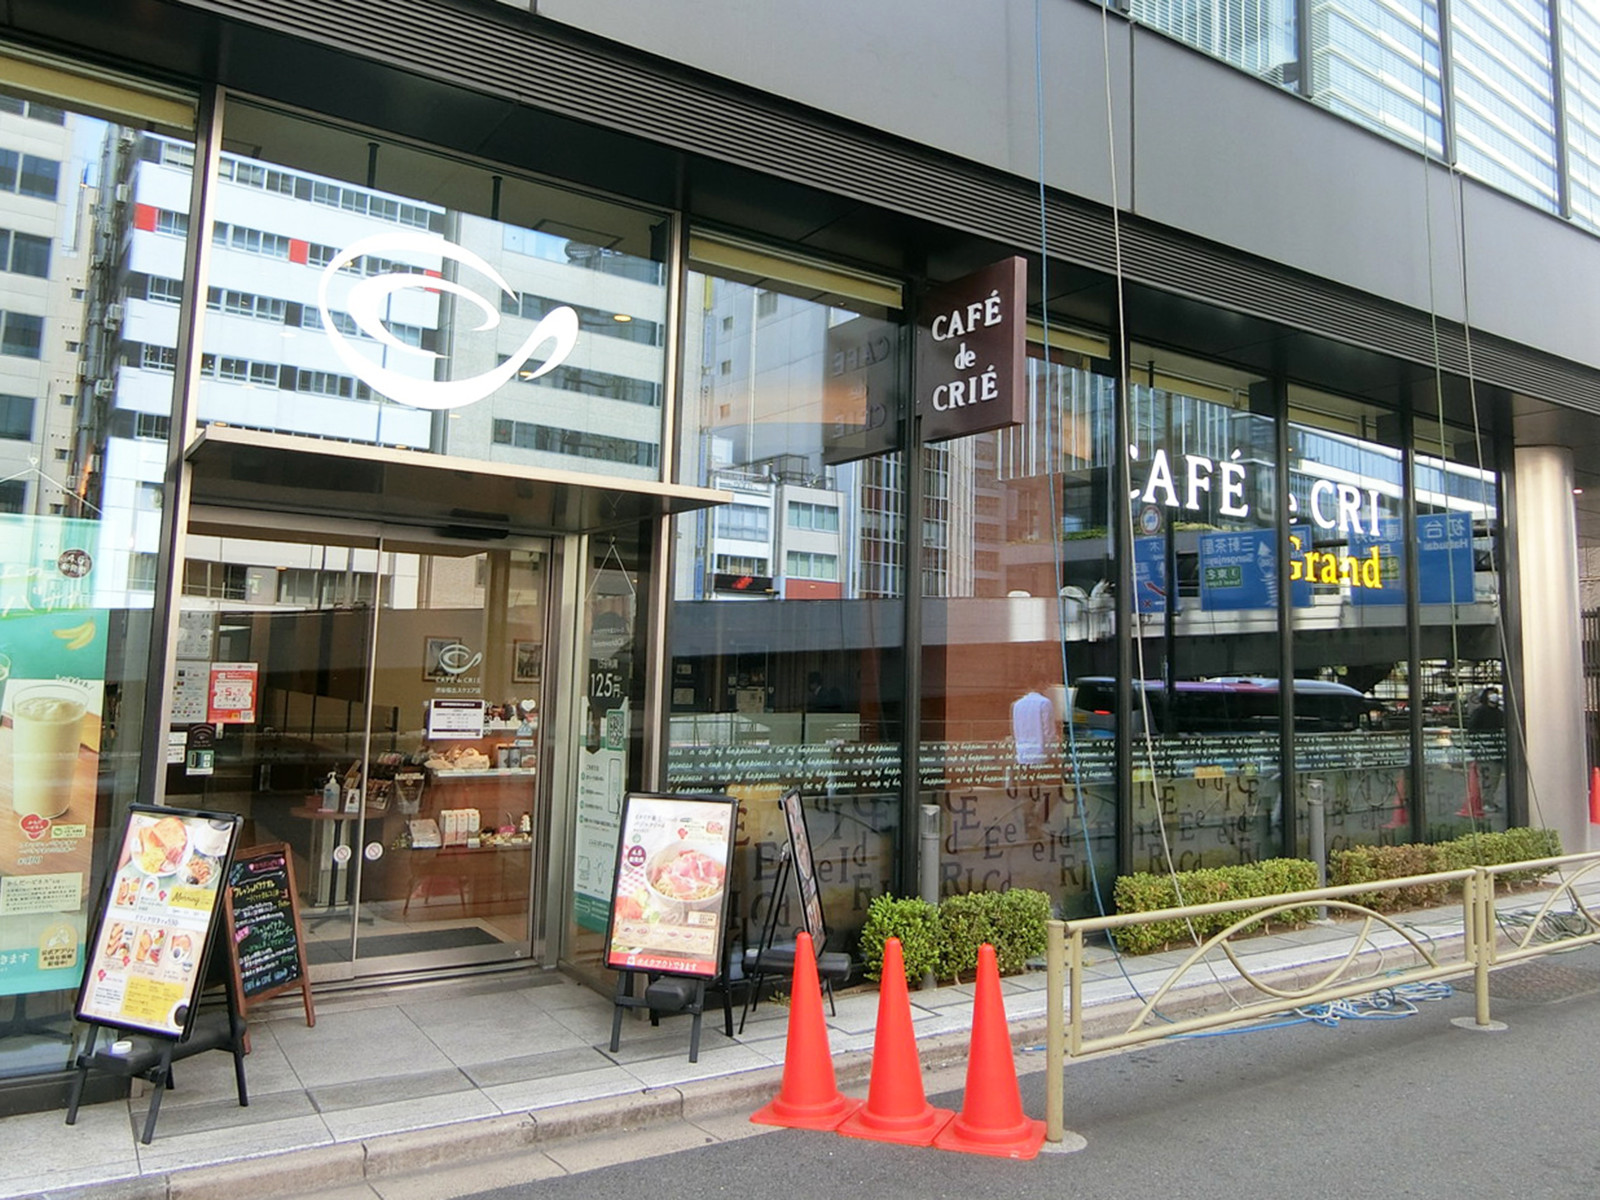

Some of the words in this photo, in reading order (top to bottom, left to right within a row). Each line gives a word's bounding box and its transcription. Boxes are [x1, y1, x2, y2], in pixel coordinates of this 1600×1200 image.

[931, 290, 1002, 341] CAFÉ
[954, 342, 976, 370] de
[932, 365, 998, 411] CRIÉ
[171, 892, 201, 907] Morning
